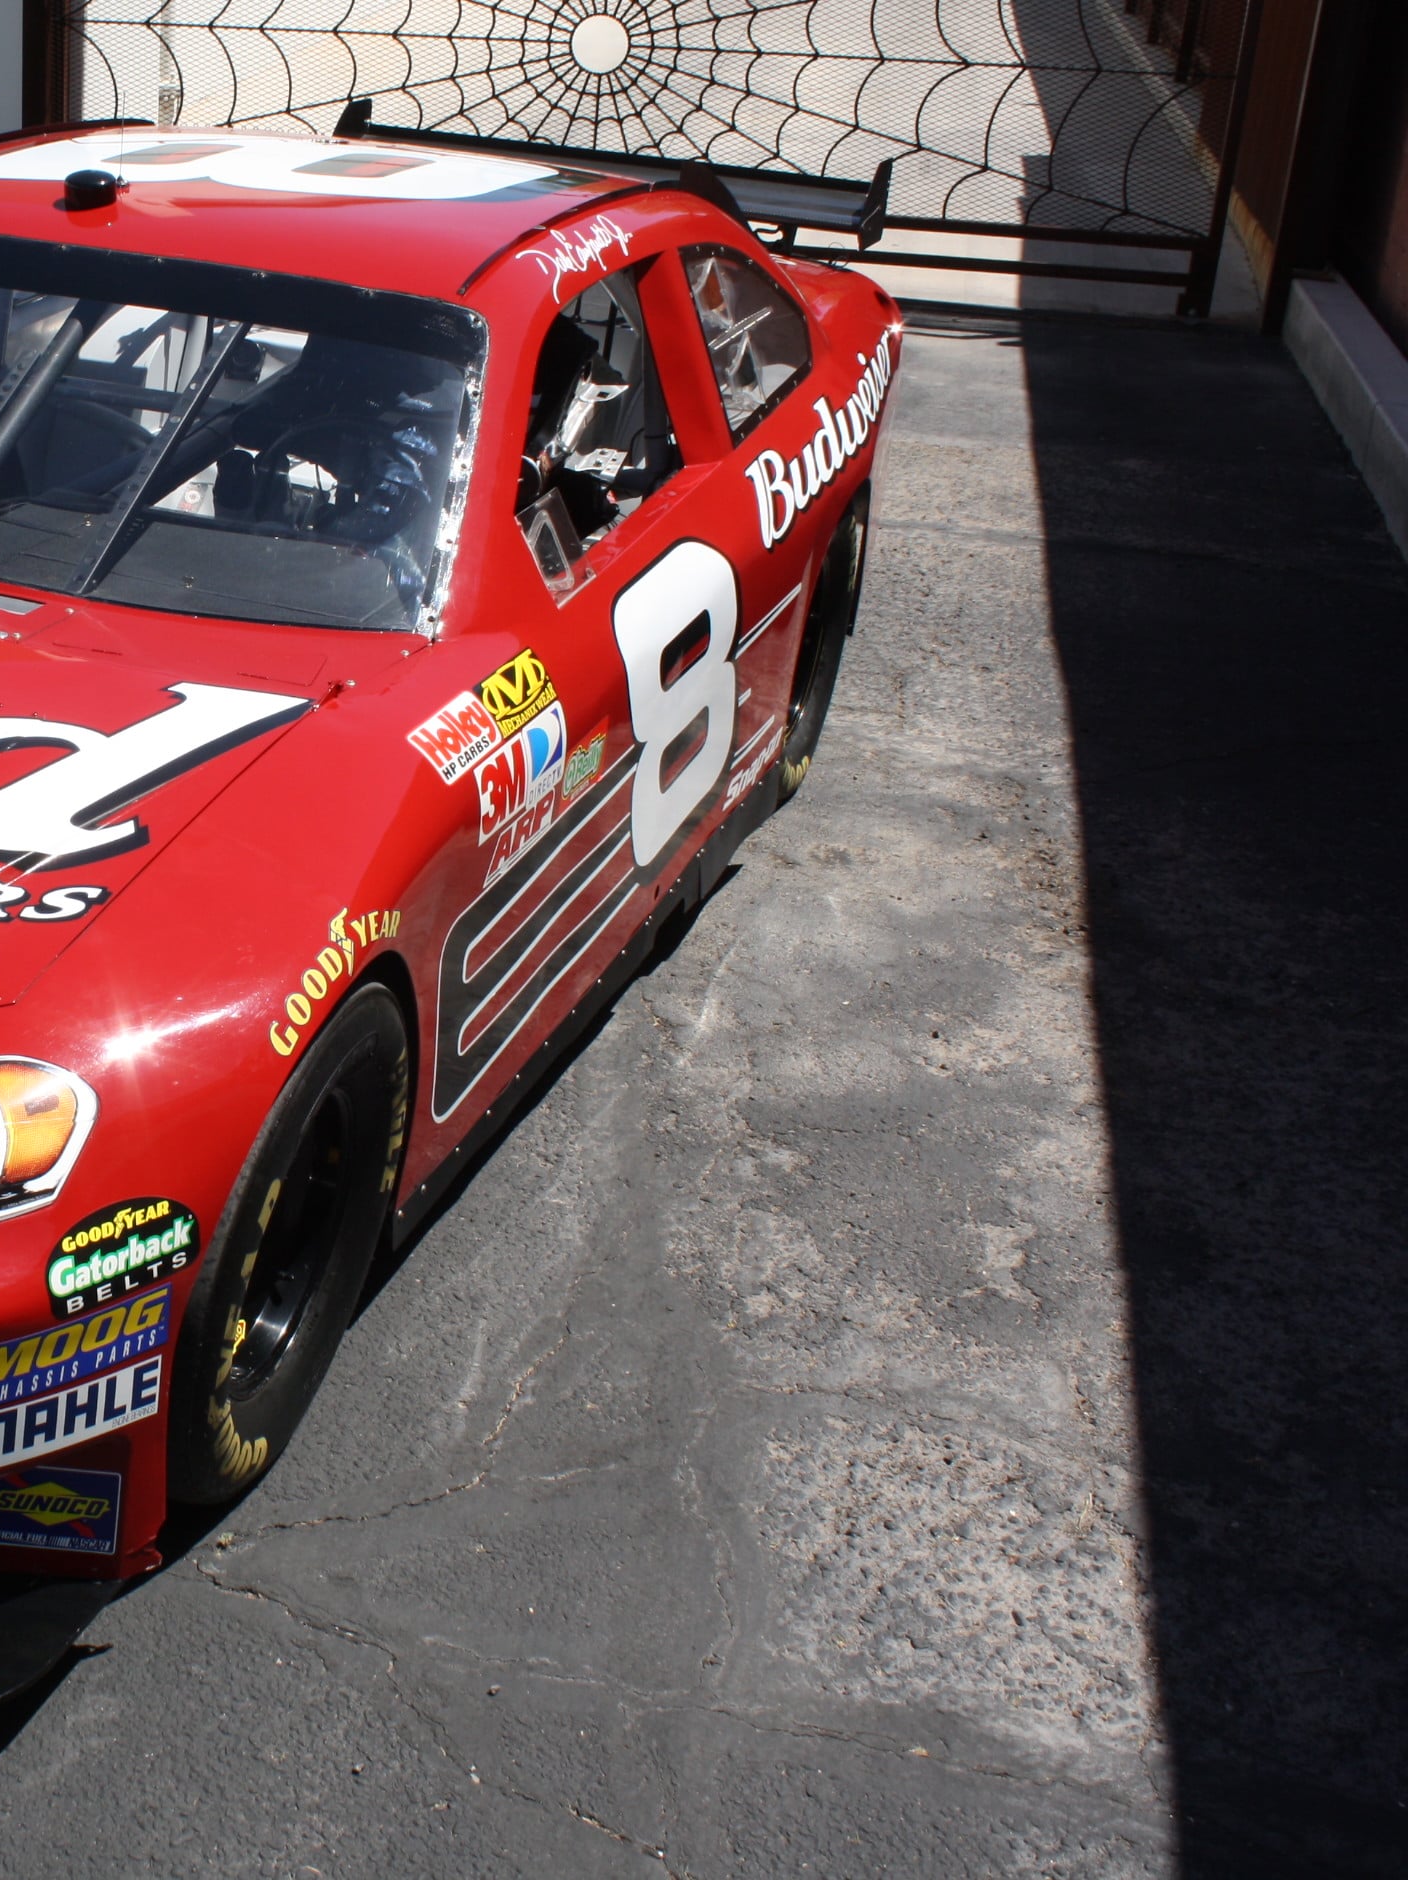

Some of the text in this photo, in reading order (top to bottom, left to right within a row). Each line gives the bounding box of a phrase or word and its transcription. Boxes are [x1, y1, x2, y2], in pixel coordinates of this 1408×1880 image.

[745, 330, 891, 549] Budweiser
[410, 700, 497, 768] Holley
[613, 540, 739, 867] 8
[442, 735, 491, 781] HP CARBS
[481, 742, 526, 836] 3M
[270, 907, 401, 1058] GOODYEAR
[49, 1216, 195, 1298] Gatorback
[61, 1200, 171, 1253] GOODYEAR
[66, 1251, 188, 1315] BELTS
[95, 1329, 157, 1369] PARTS
